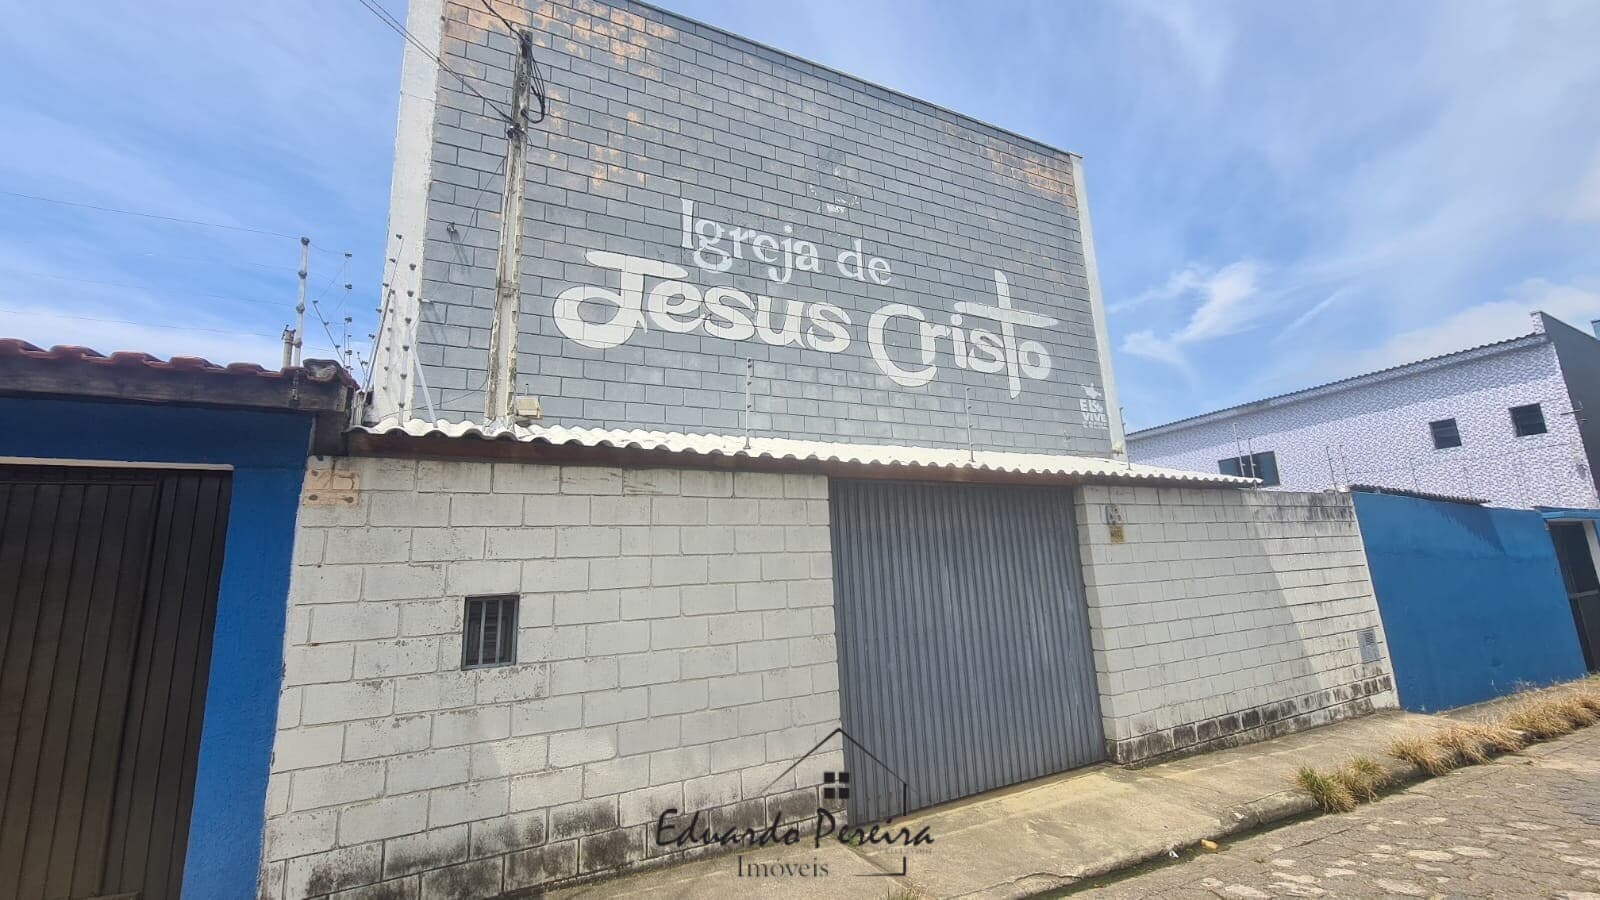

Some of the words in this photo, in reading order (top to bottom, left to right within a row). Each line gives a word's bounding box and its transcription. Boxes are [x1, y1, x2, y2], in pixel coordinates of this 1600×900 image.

[681, 198, 823, 284] Igreja
[837, 238, 892, 285] de
[552, 250, 851, 352] Jesus
[868, 269, 1058, 399] Cristo
